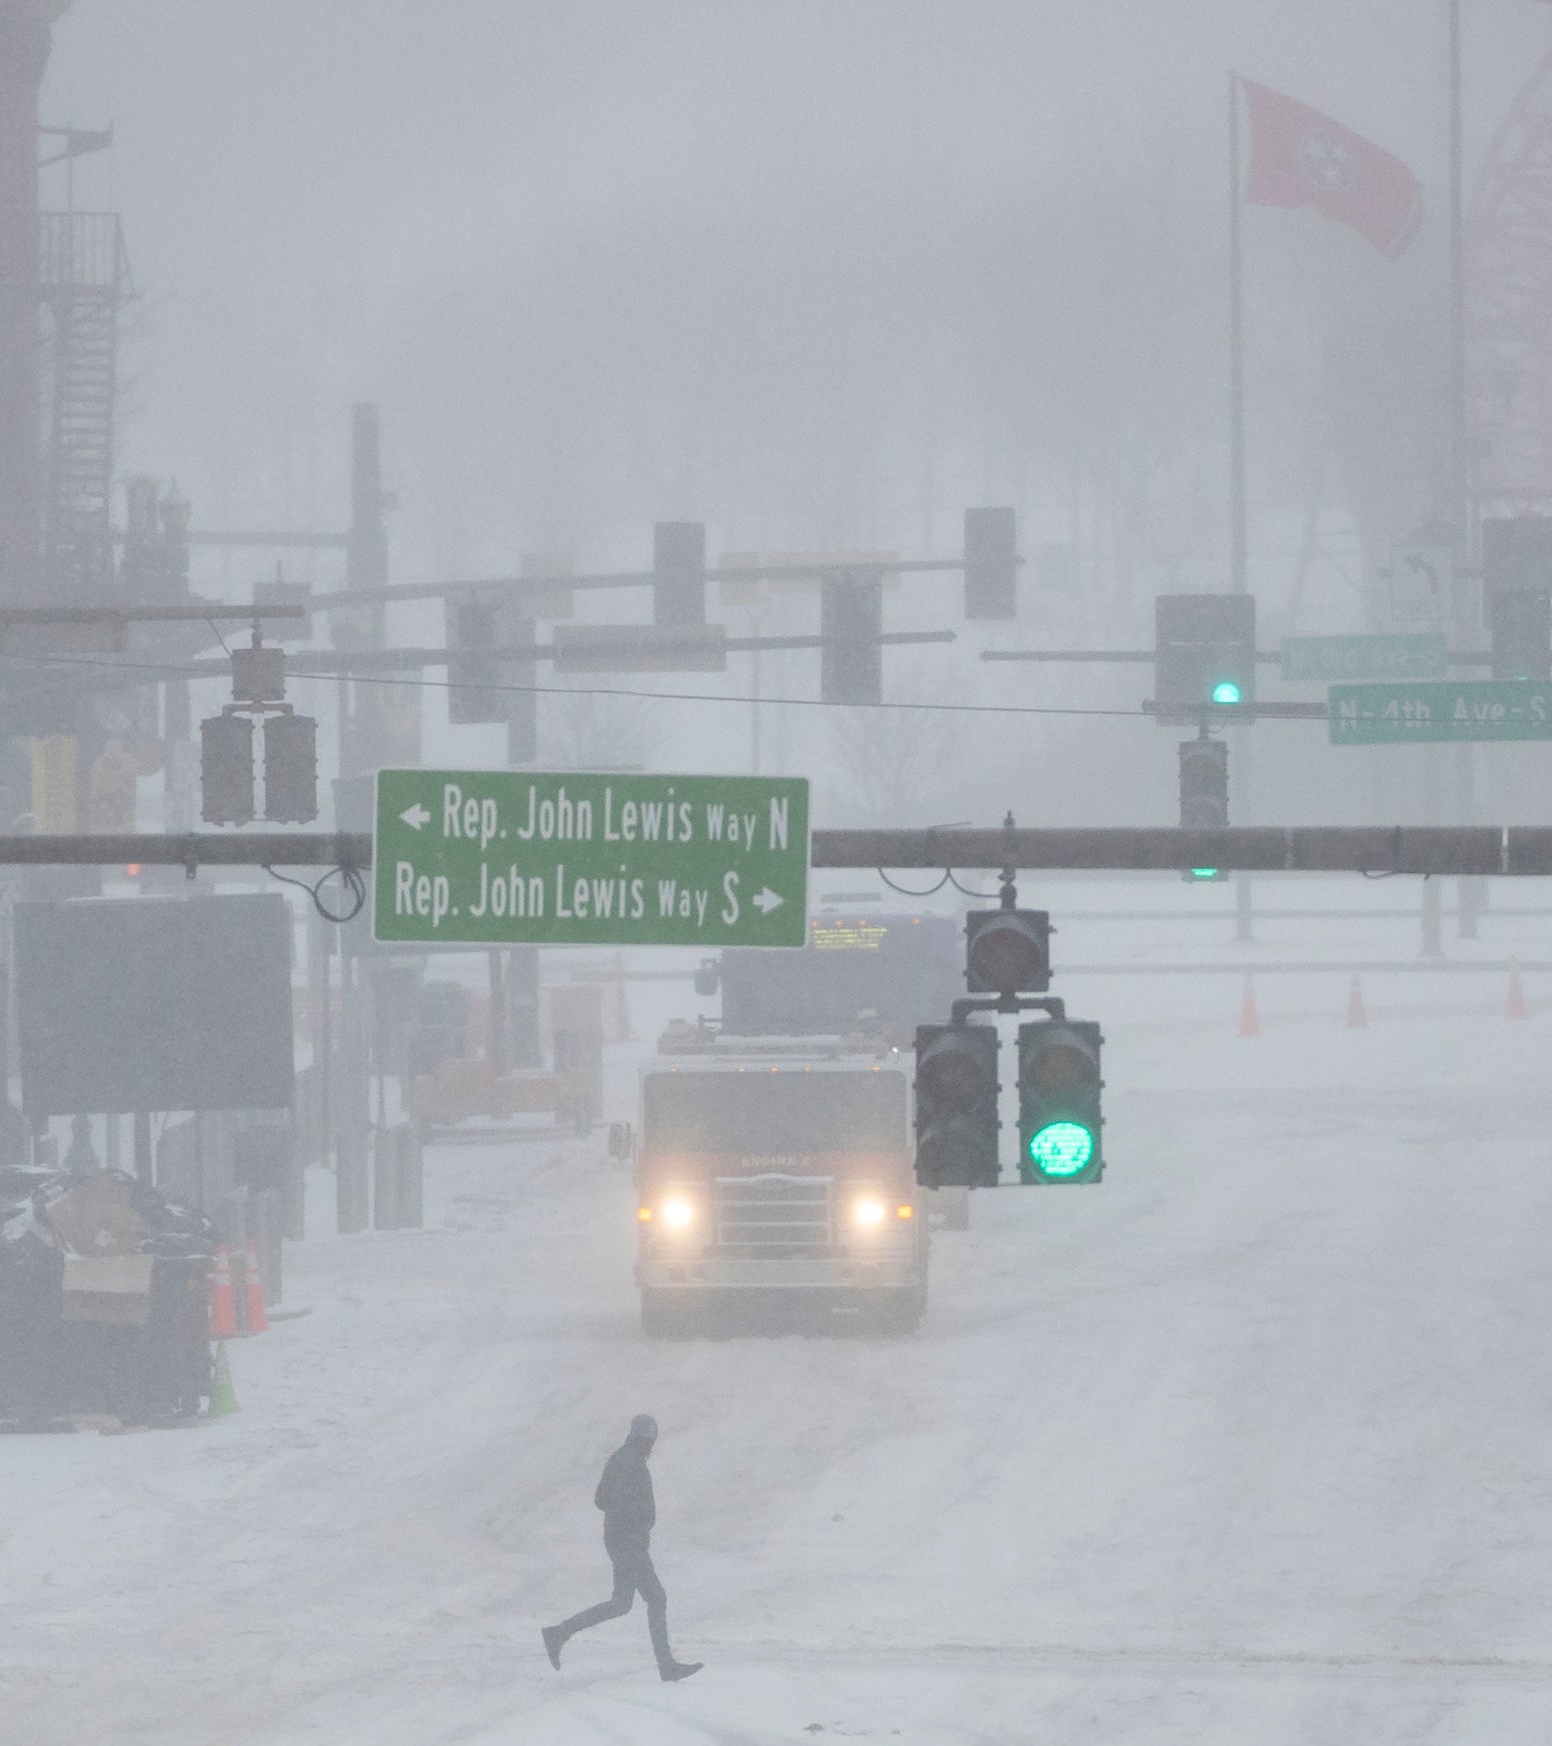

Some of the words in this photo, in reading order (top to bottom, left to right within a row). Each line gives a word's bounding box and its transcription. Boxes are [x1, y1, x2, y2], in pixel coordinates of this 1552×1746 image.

[443, 784, 507, 850] Rep.
[517, 785, 593, 841] John
[604, 786, 693, 842] Lewis
[705, 802, 757, 851] Way
[769, 797, 789, 850] N
[394, 861, 460, 927] Rep.
[469, 863, 544, 918] John
[556, 864, 645, 919] Lewis
[657, 880, 708, 927] Way
[722, 870, 741, 924] S
